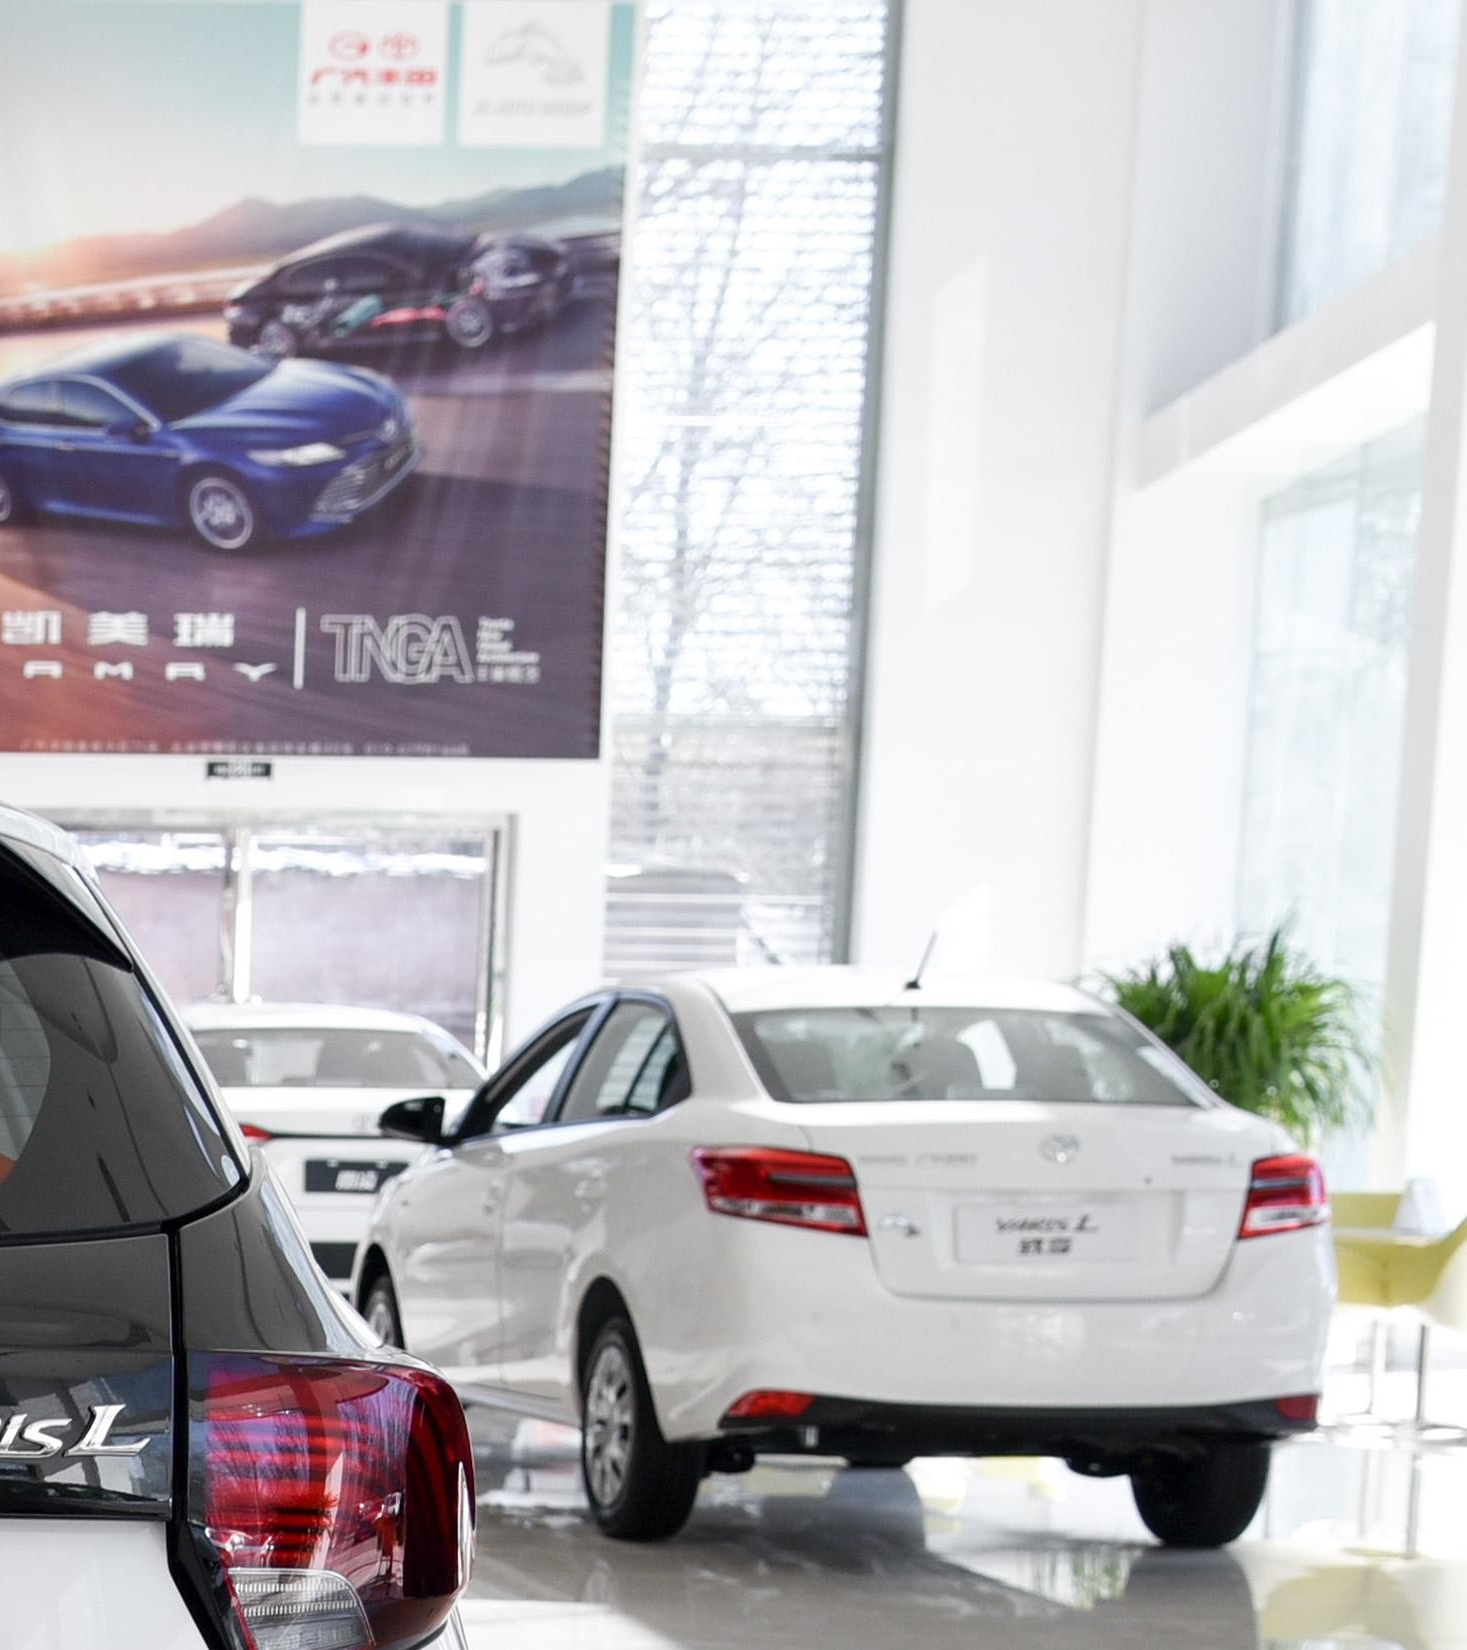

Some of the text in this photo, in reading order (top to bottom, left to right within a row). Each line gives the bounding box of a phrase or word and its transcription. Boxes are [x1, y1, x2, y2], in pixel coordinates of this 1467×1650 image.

[1, 610, 235, 647] 凯美瑞
[320, 613, 475, 685] TNGA
